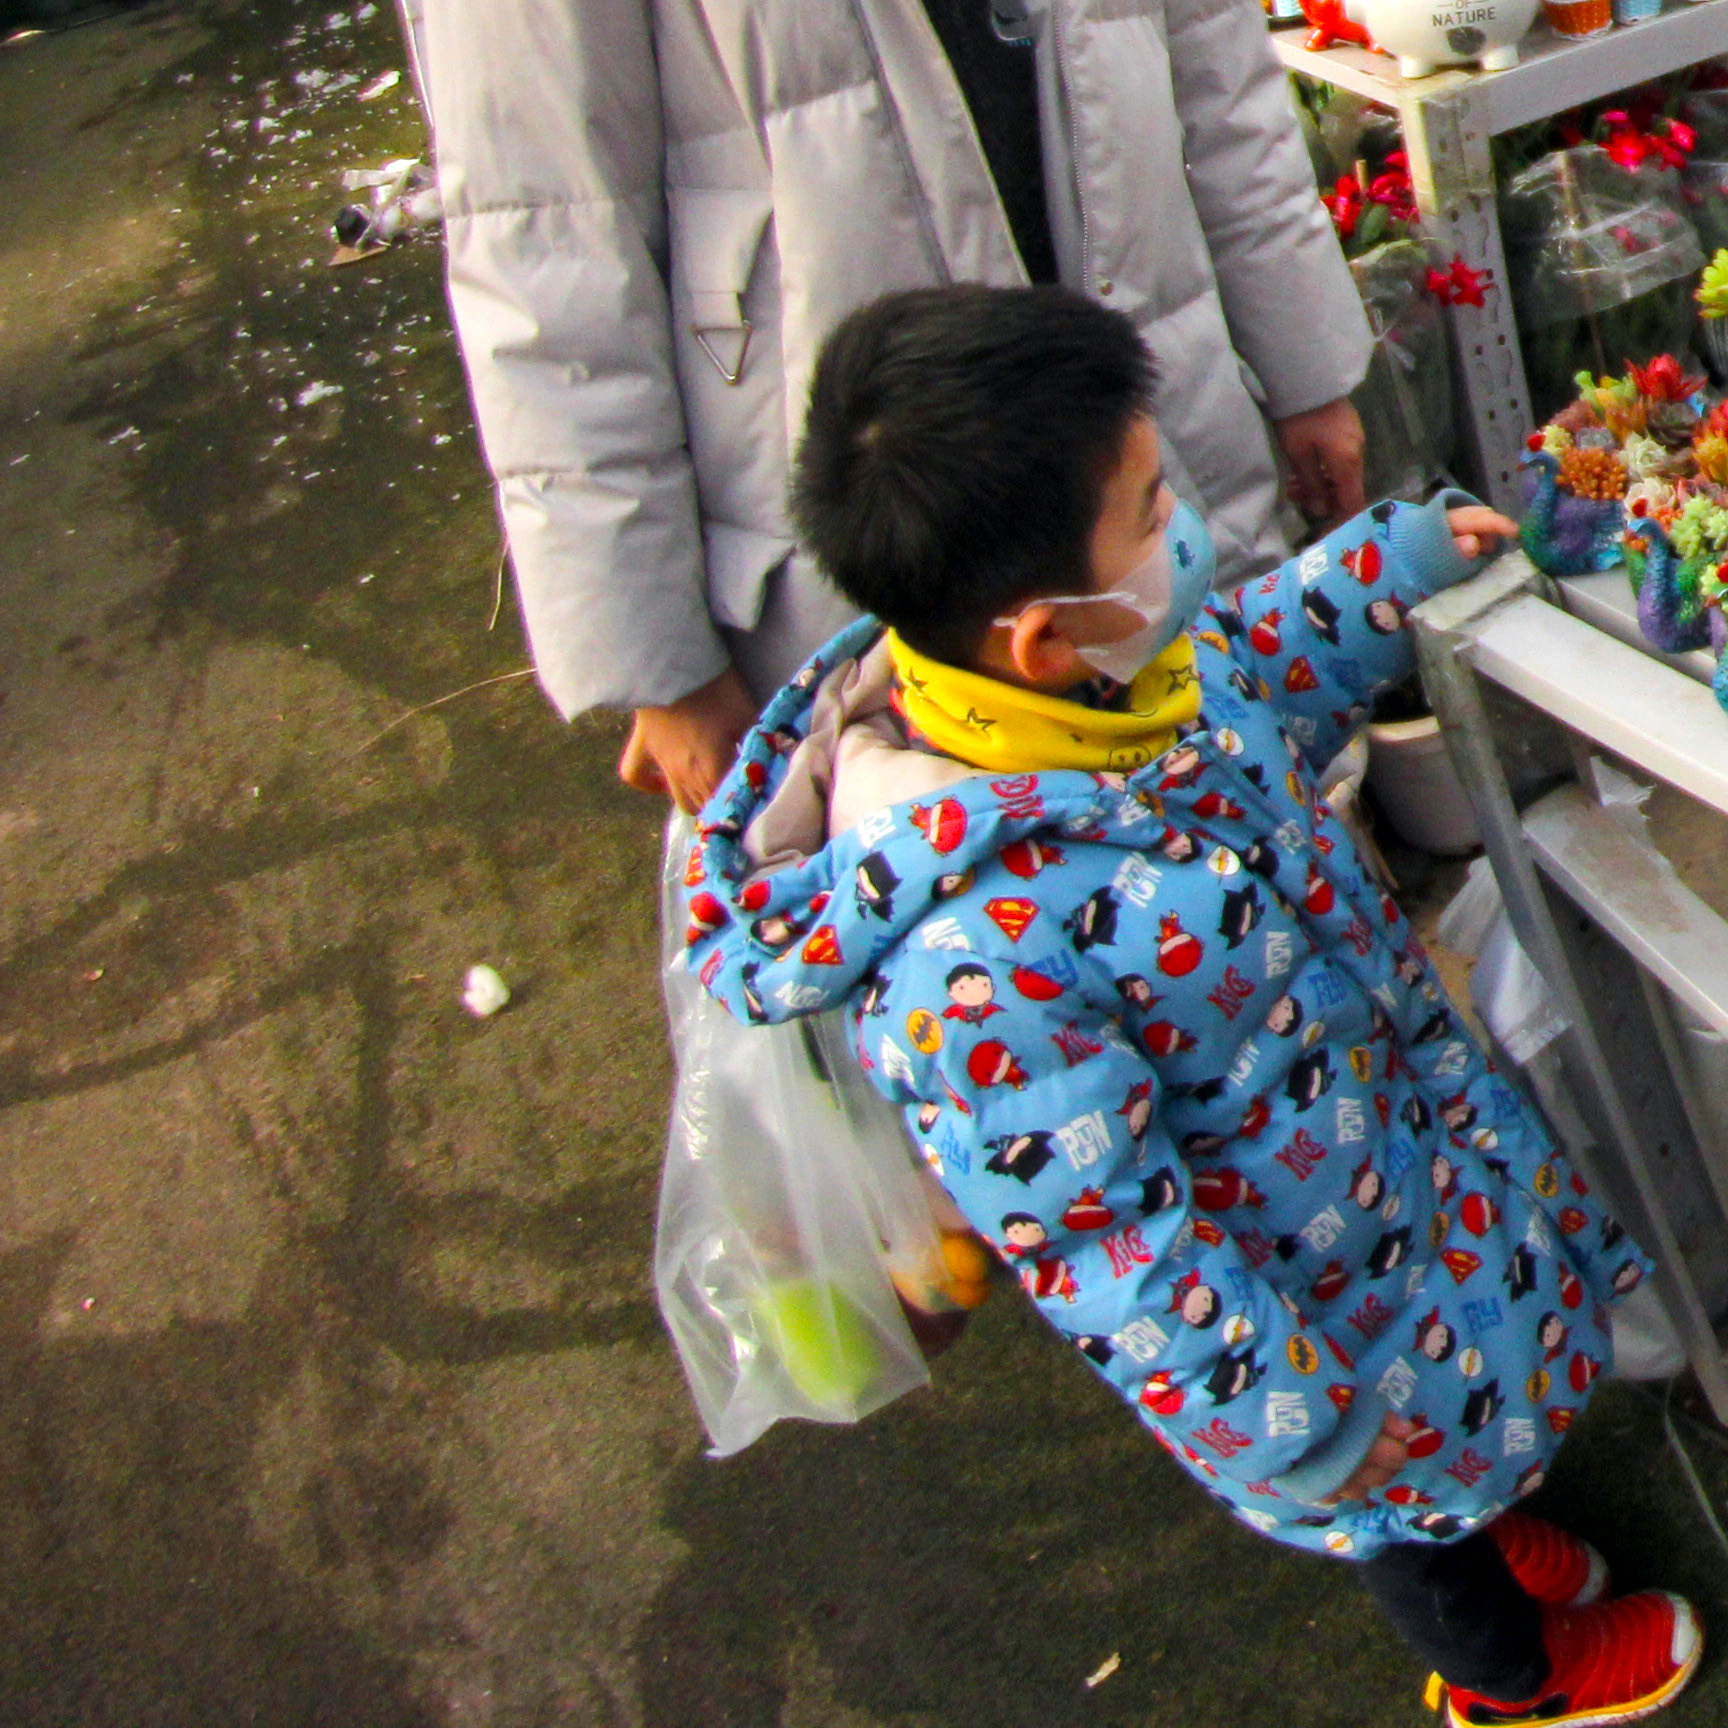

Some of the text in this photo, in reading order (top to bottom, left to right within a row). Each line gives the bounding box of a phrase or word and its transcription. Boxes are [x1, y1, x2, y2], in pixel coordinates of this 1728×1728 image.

[1431, 6, 1497, 27] NATURE
[1054, 1109, 1114, 1172] RUN
[1266, 1390, 1312, 1438] RUN
